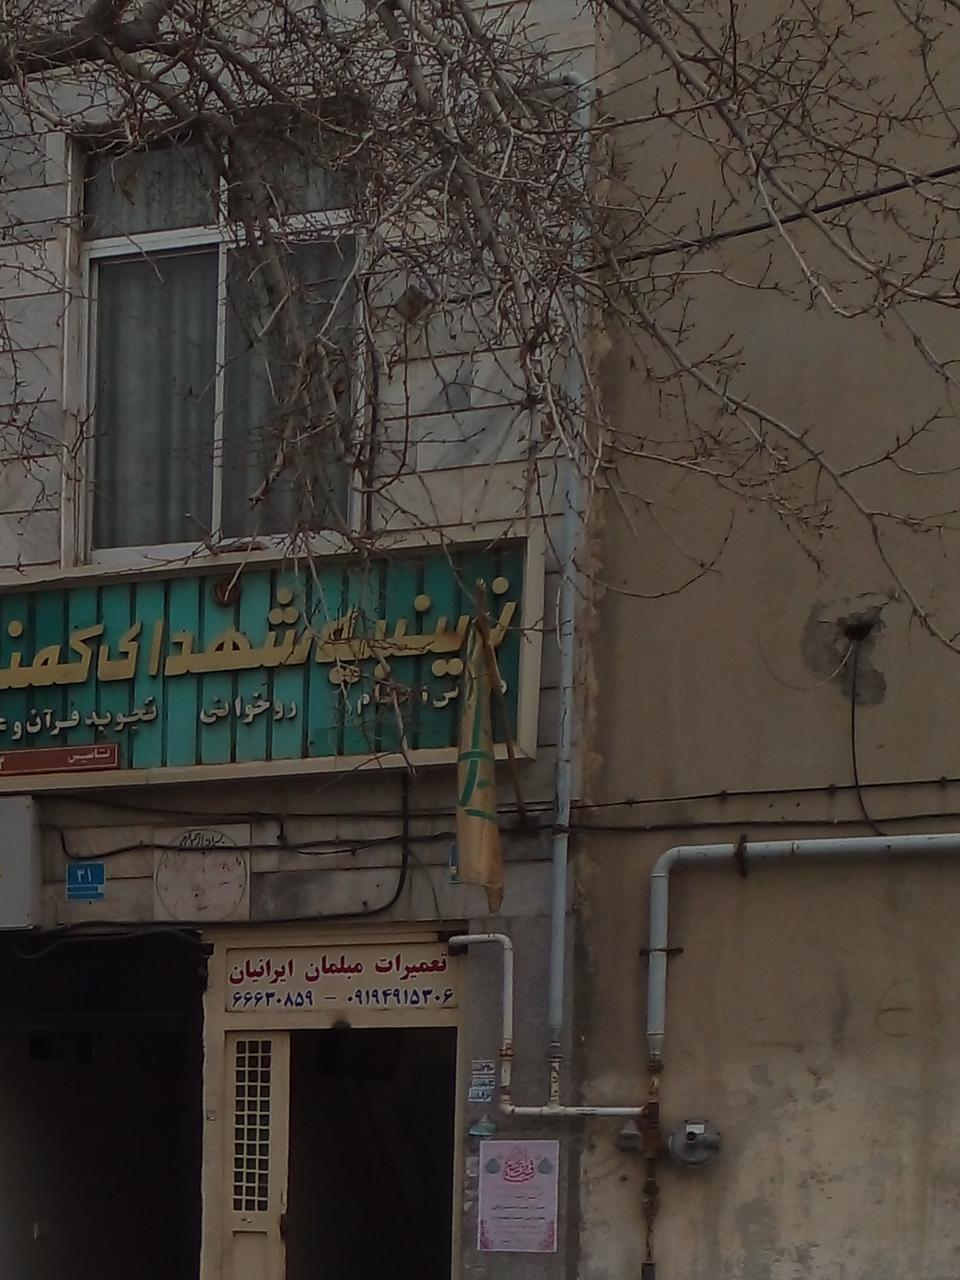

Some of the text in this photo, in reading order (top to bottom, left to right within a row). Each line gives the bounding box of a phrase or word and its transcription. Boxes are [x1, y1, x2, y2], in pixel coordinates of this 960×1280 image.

[97, 587, 315, 683] شهدای
[200, 691, 298, 725] روخوانی
[12, 716, 24, 741] و
[229, 952, 449, 984] تعمیرات مبلمان ایرانیان
[231, 988, 454, 1008] ۰۹۱۹۴۹۱۵۳۰۶ ۶۶۶۳۰۸۵۹
